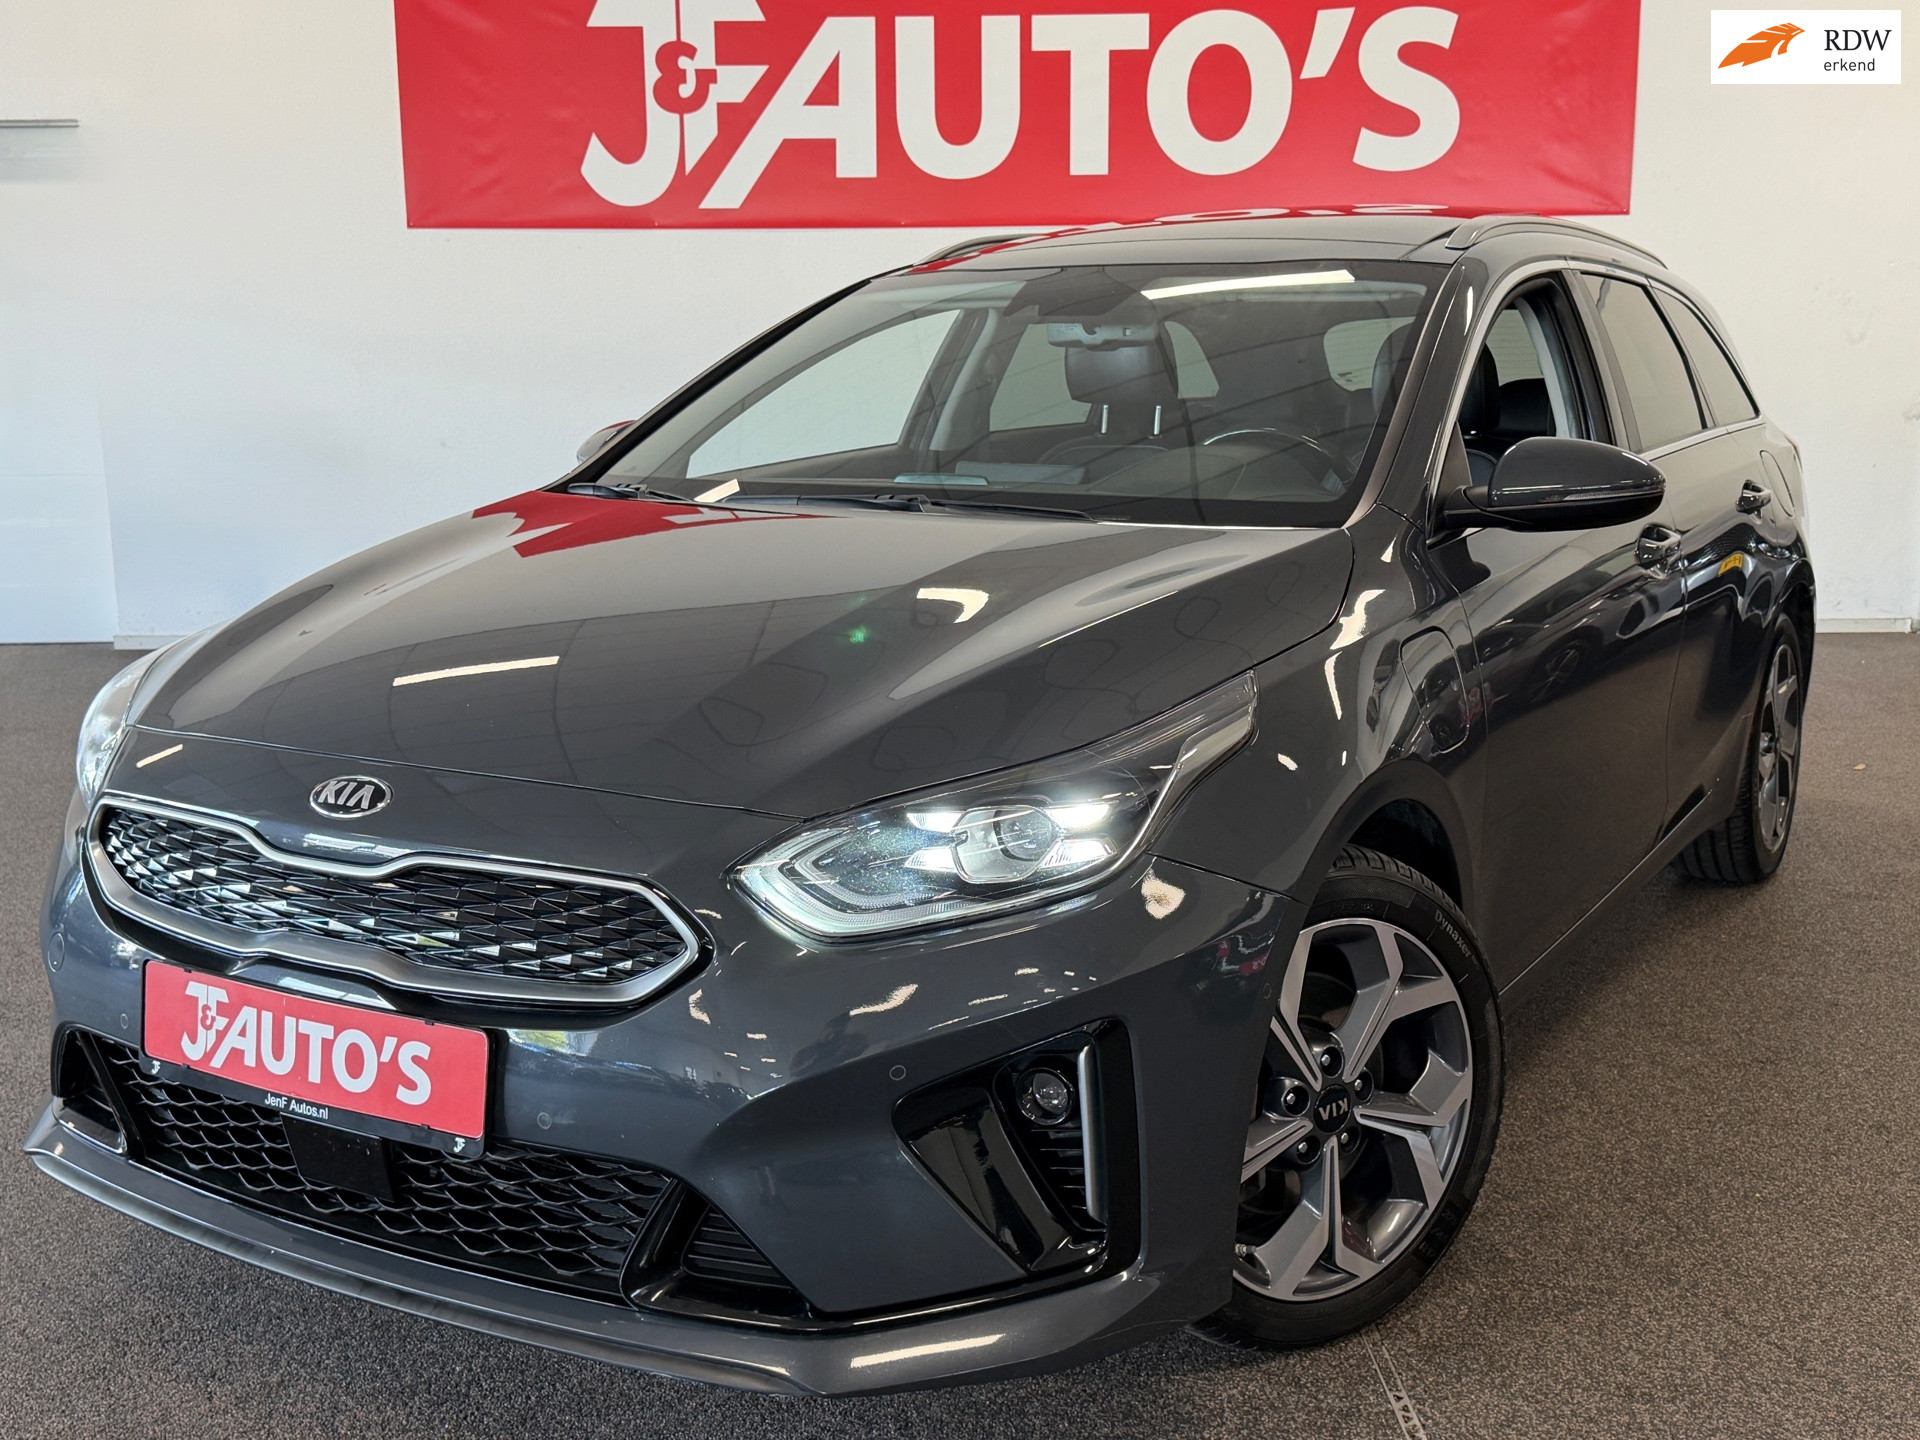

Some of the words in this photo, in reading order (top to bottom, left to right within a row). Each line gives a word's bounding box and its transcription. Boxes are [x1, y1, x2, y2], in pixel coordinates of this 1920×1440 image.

[317, 780, 375, 810] KIA
[1434, 909, 1472, 958] Dynaxer
[264, 1092, 288, 1109] JenF
[289, 1099, 329, 1120] Autos.nl
[1318, 1097, 1349, 1122] KIA
